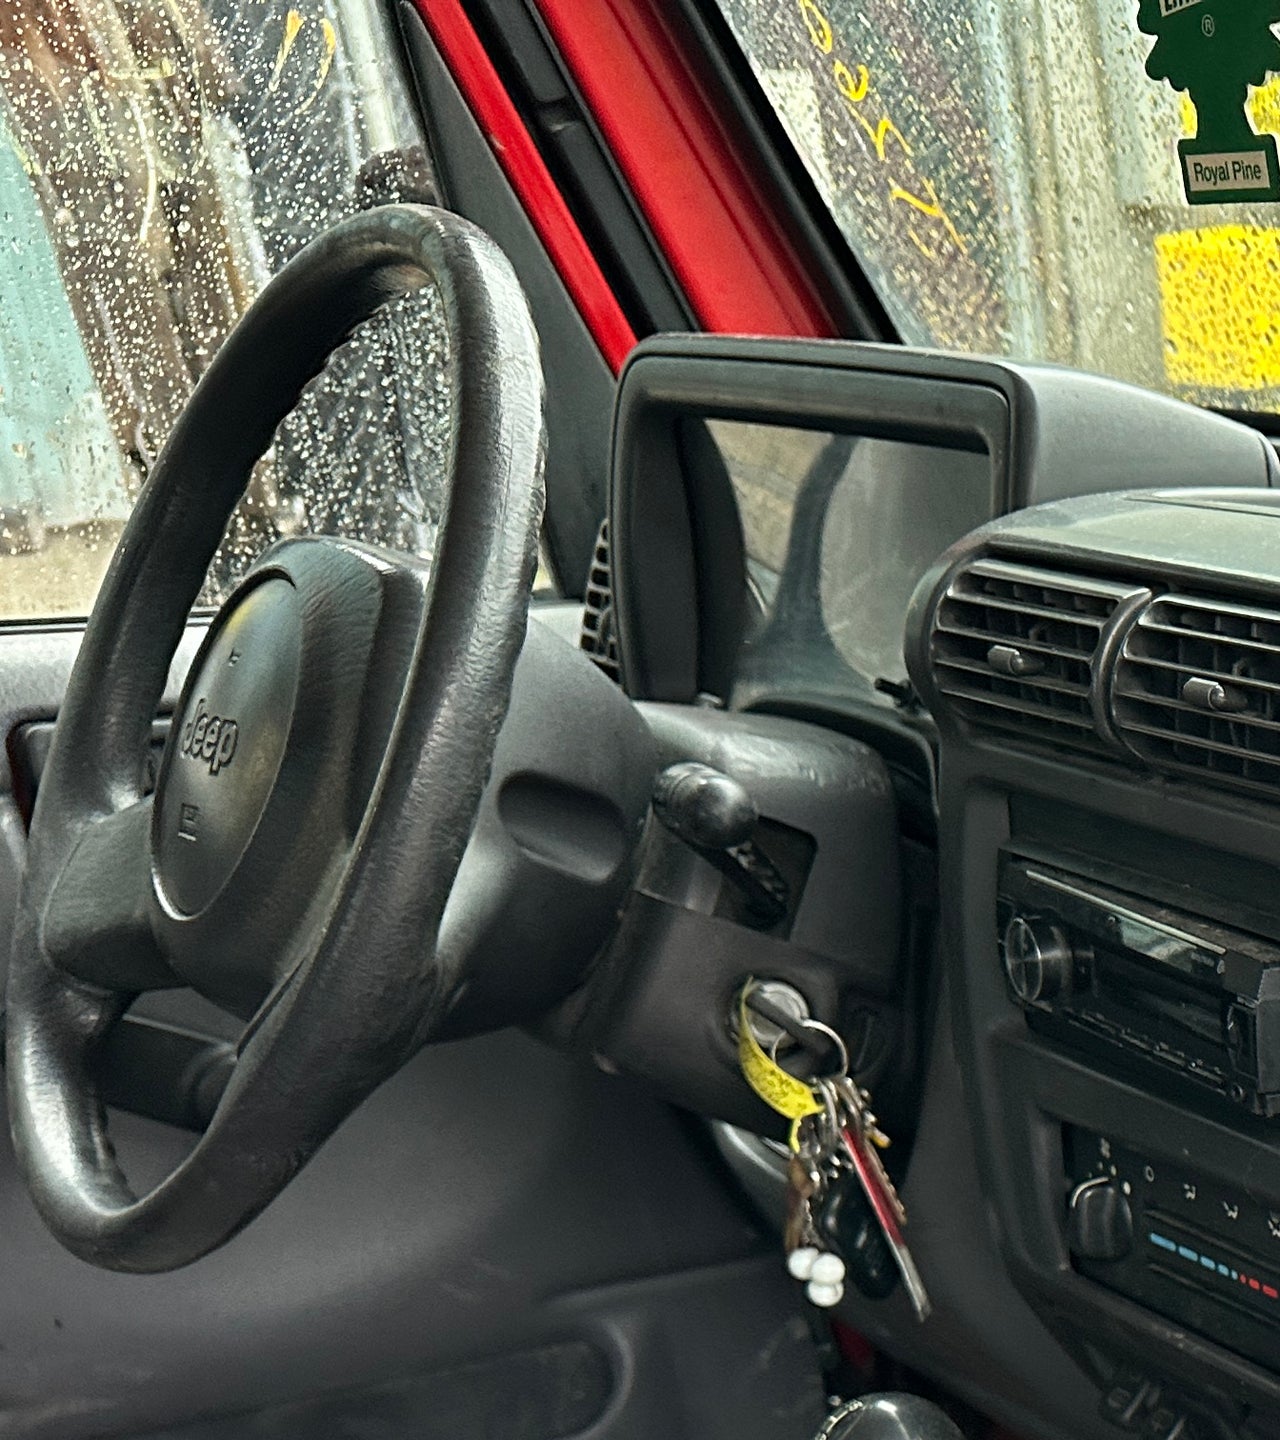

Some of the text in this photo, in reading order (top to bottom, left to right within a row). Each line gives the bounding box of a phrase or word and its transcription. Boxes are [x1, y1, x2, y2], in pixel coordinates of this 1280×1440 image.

[1193, 160, 1262, 186] Royal Pine
[181, 697, 239, 777] Jeep
